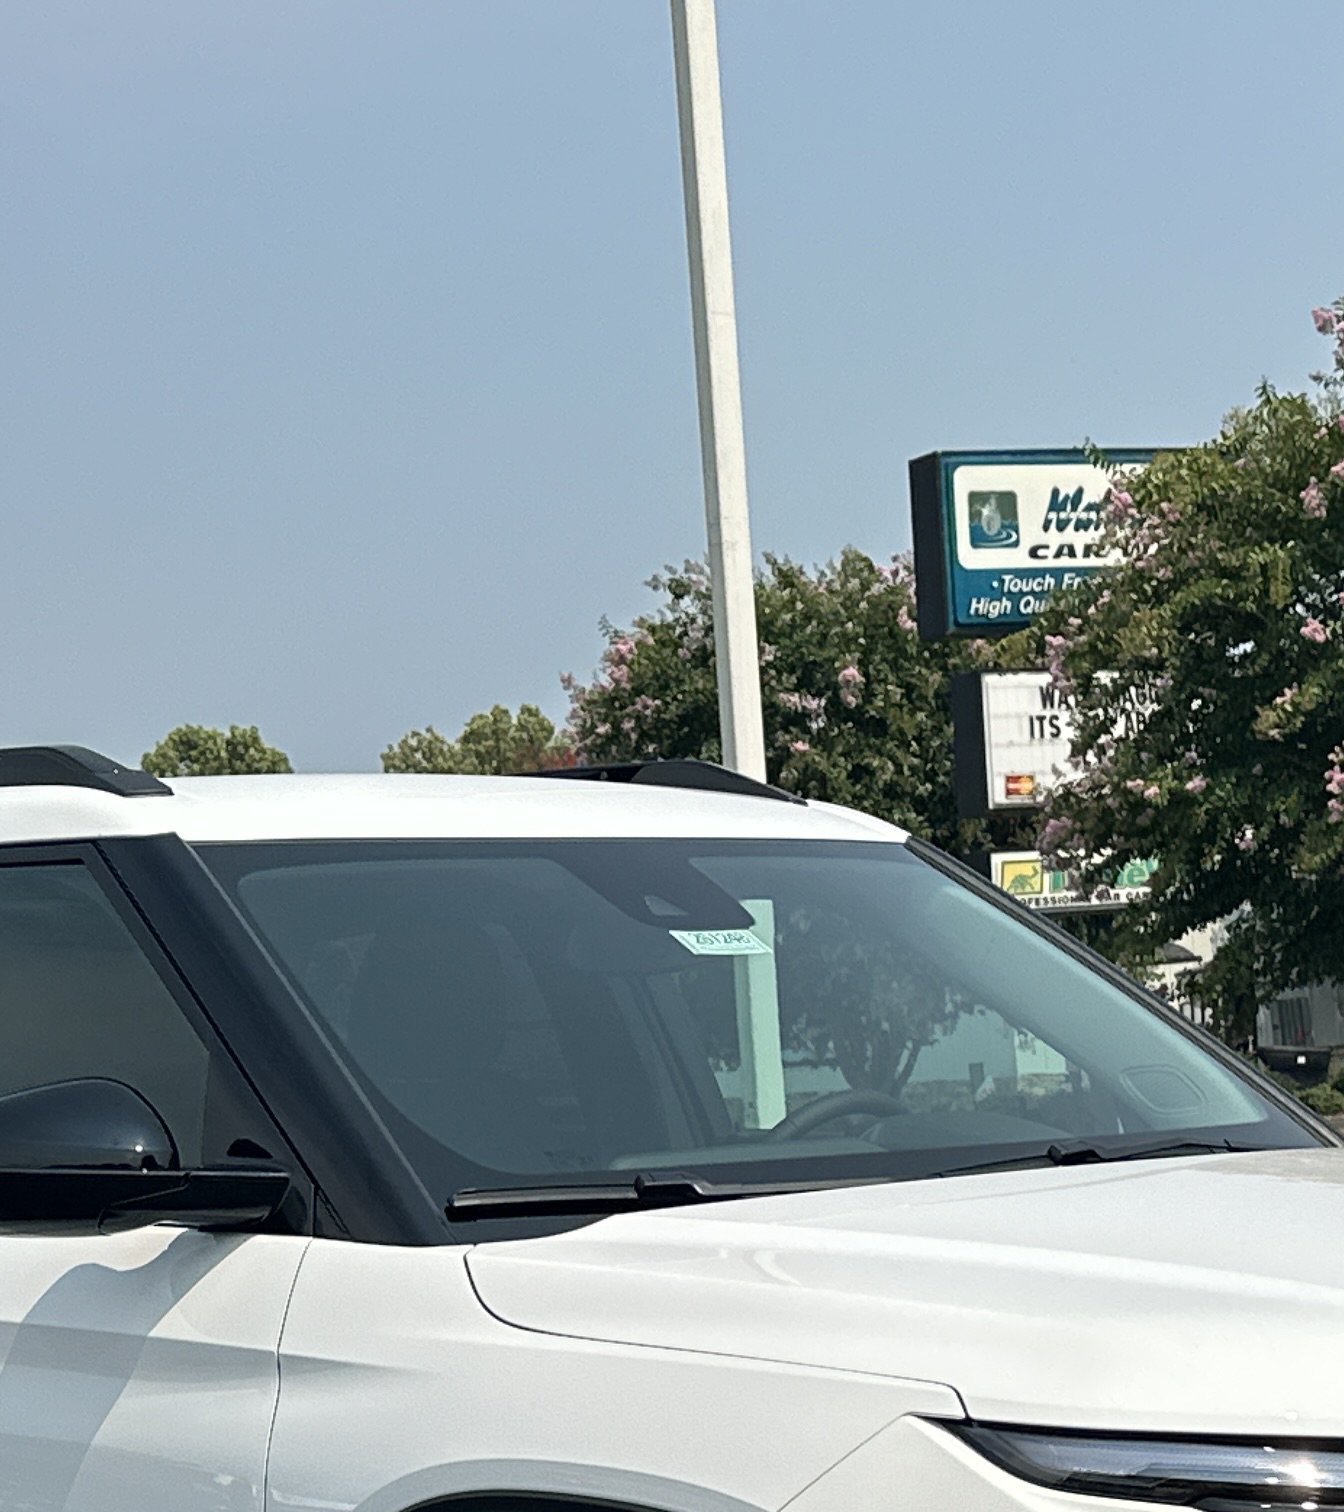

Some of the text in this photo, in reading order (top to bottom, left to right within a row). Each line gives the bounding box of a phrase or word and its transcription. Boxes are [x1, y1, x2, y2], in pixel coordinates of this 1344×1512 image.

[1001, 573, 1056, 593] Touch
[969, 597, 1012, 619] High
[1029, 714, 1061, 739] ITS
